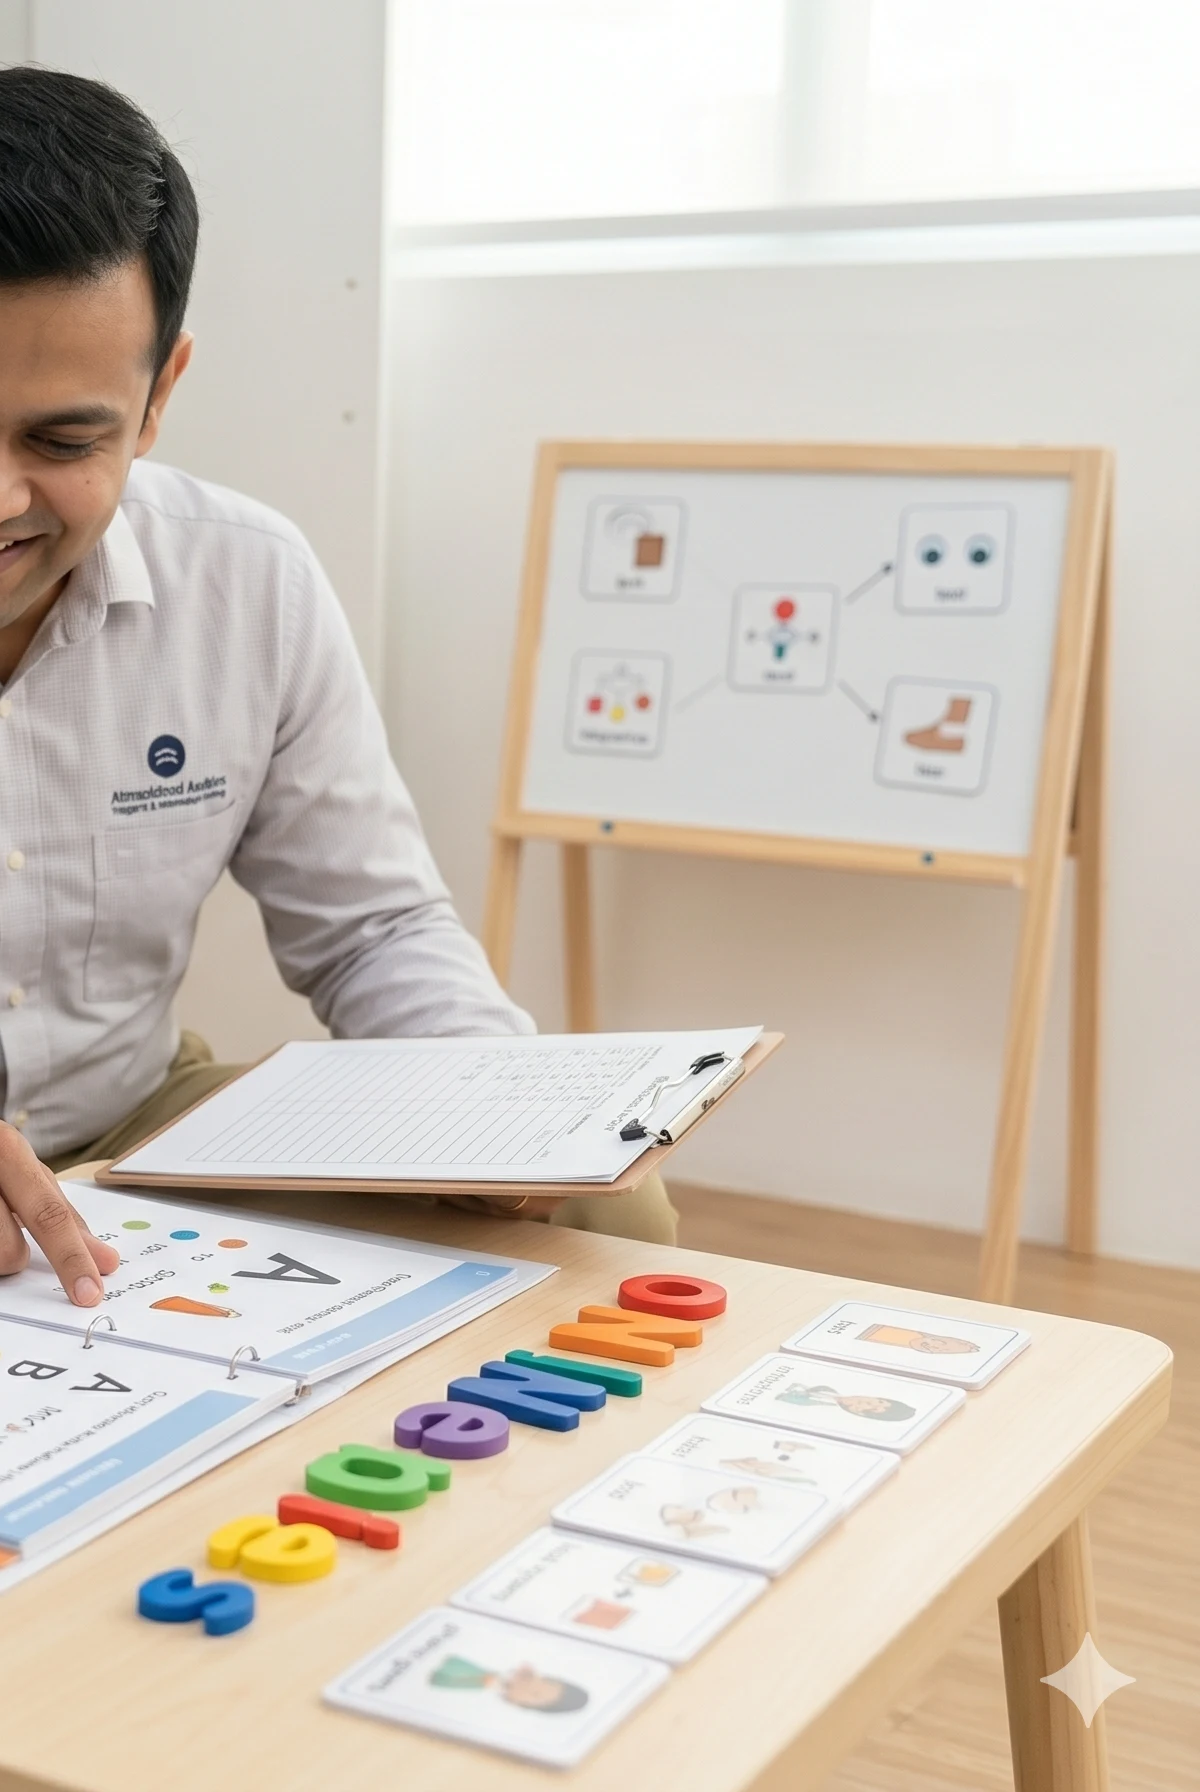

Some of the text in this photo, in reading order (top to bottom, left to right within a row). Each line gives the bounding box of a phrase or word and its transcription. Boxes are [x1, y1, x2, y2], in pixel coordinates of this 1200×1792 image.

[231, 1253, 341, 1284] A
[8, 1360, 68, 1380] B
[69, 1373, 132, 1392] A
